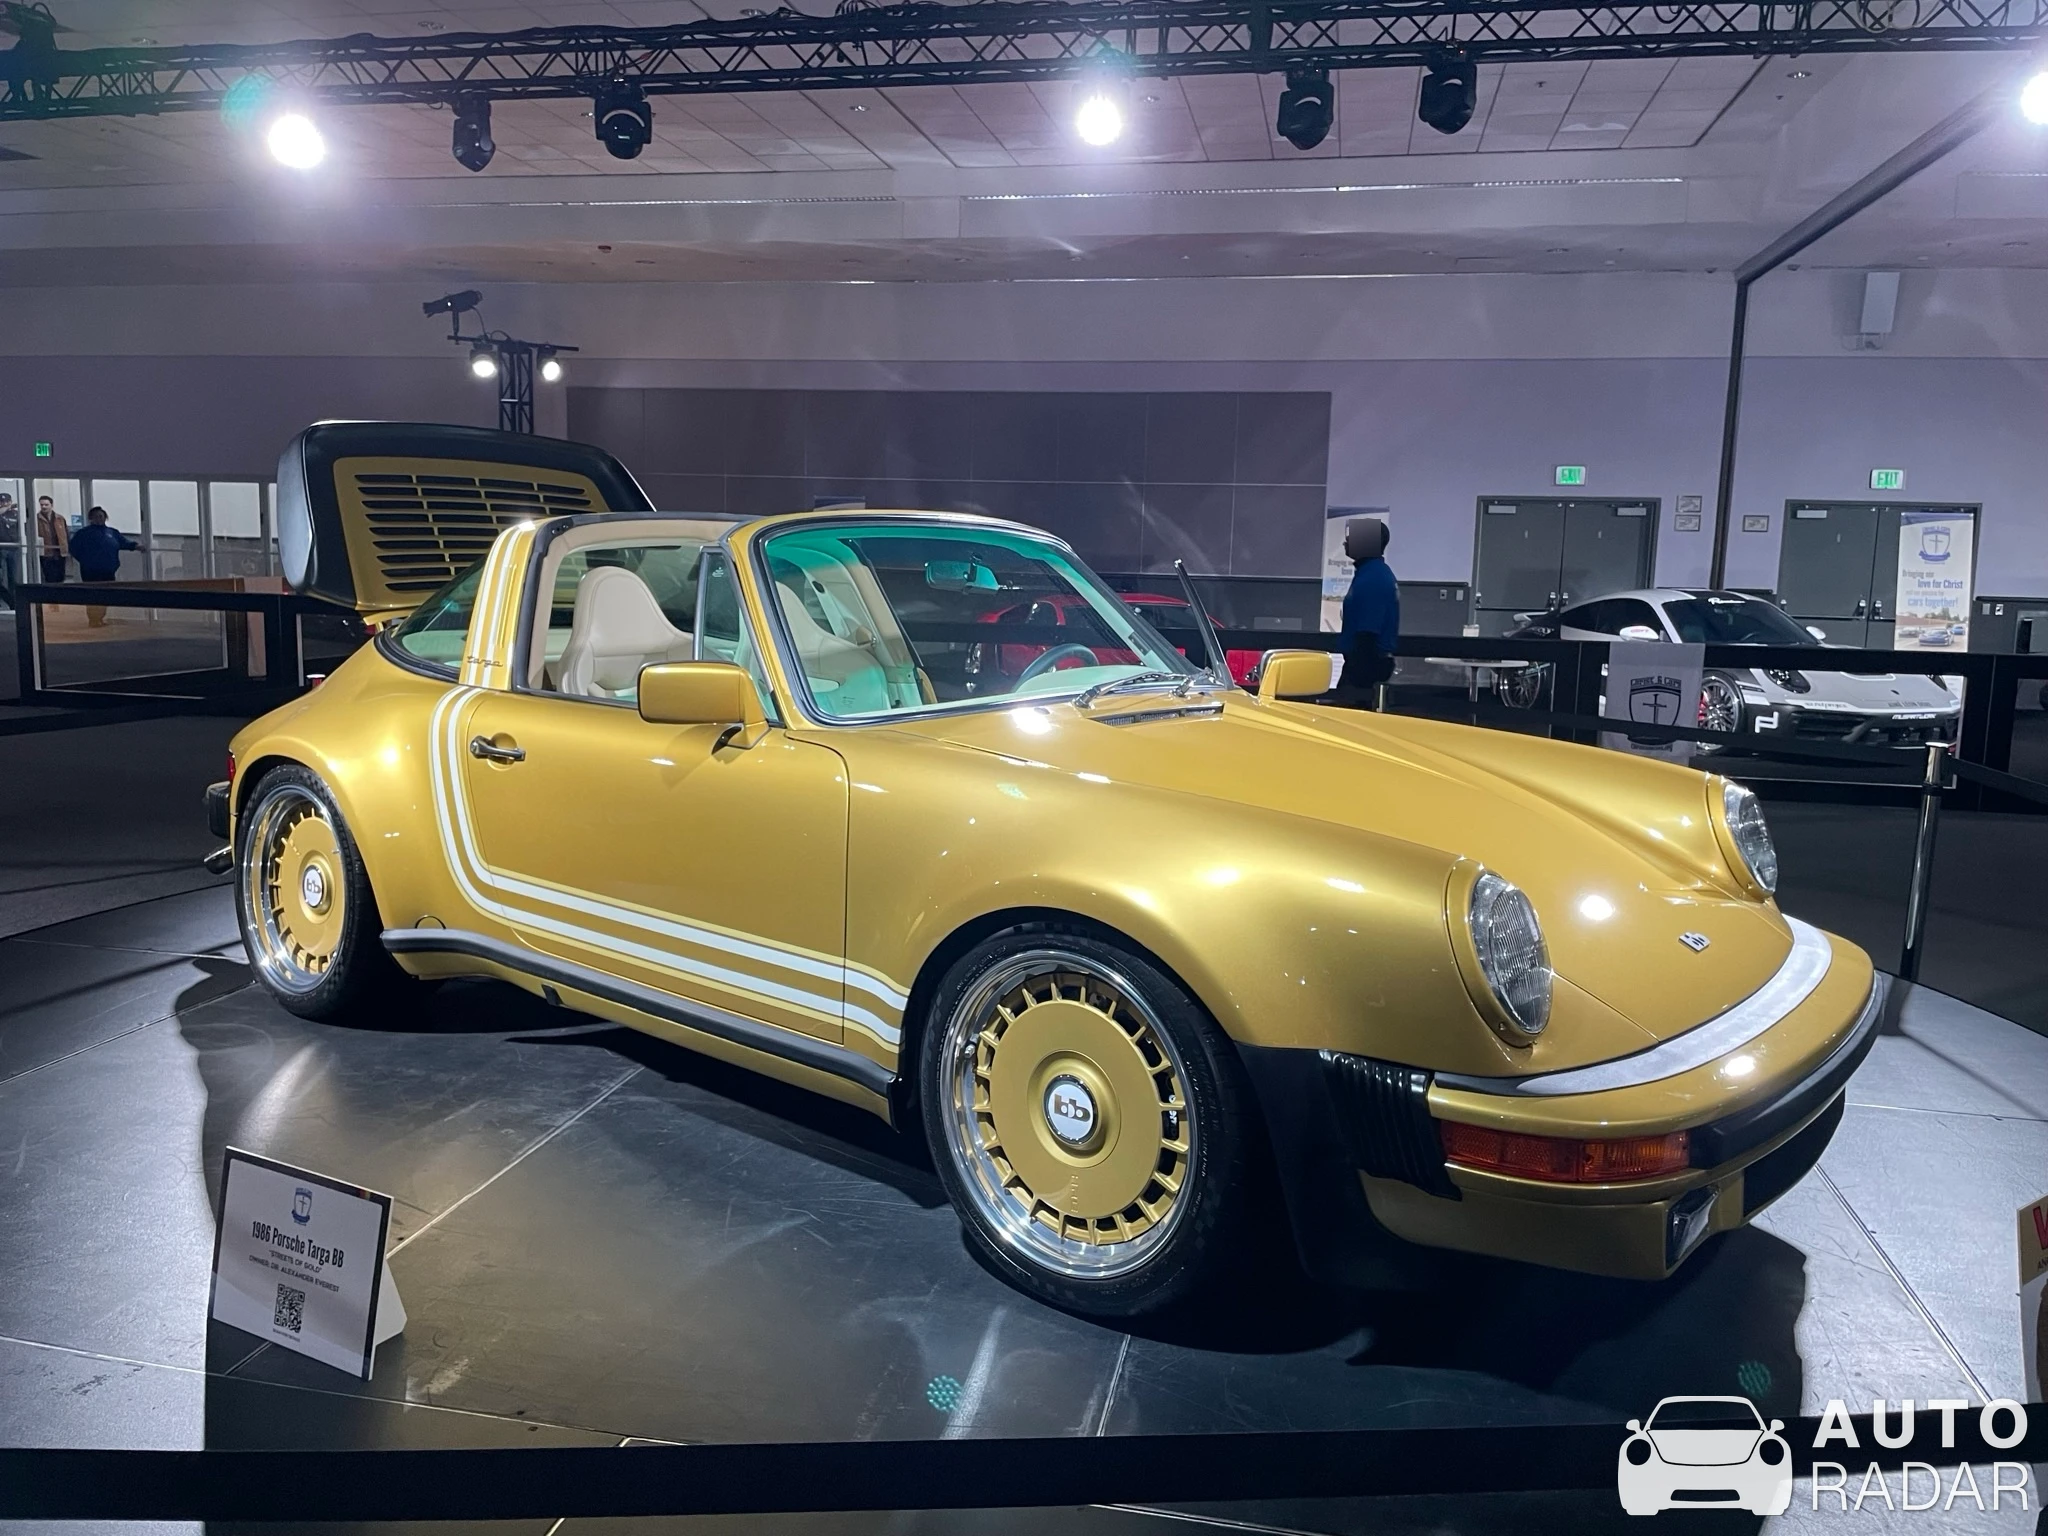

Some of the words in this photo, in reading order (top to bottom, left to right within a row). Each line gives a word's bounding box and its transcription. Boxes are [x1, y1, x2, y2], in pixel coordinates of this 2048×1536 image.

[1561, 468, 1581, 482] EXIT
[1877, 472, 1899, 486] EXIT
[1902, 569, 1925, 578] Bringing
[1918, 579, 1931, 588] love
[1932, 580, 1942, 588] for
[1943, 580, 1963, 589] Christ
[1907, 598, 1923, 607] cars
[1925, 597, 1958, 608] together!
[1054, 1093, 1090, 1122] bb
[252, 1221, 271, 1242] 1986
[272, 1227, 305, 1254] Porsche
[308, 1238, 330, 1265] Targa
[332, 1247, 344, 1267] BB
[281, 1266, 313, 1283] ALEXANDER
[315, 1278, 339, 1292] EVEREST
